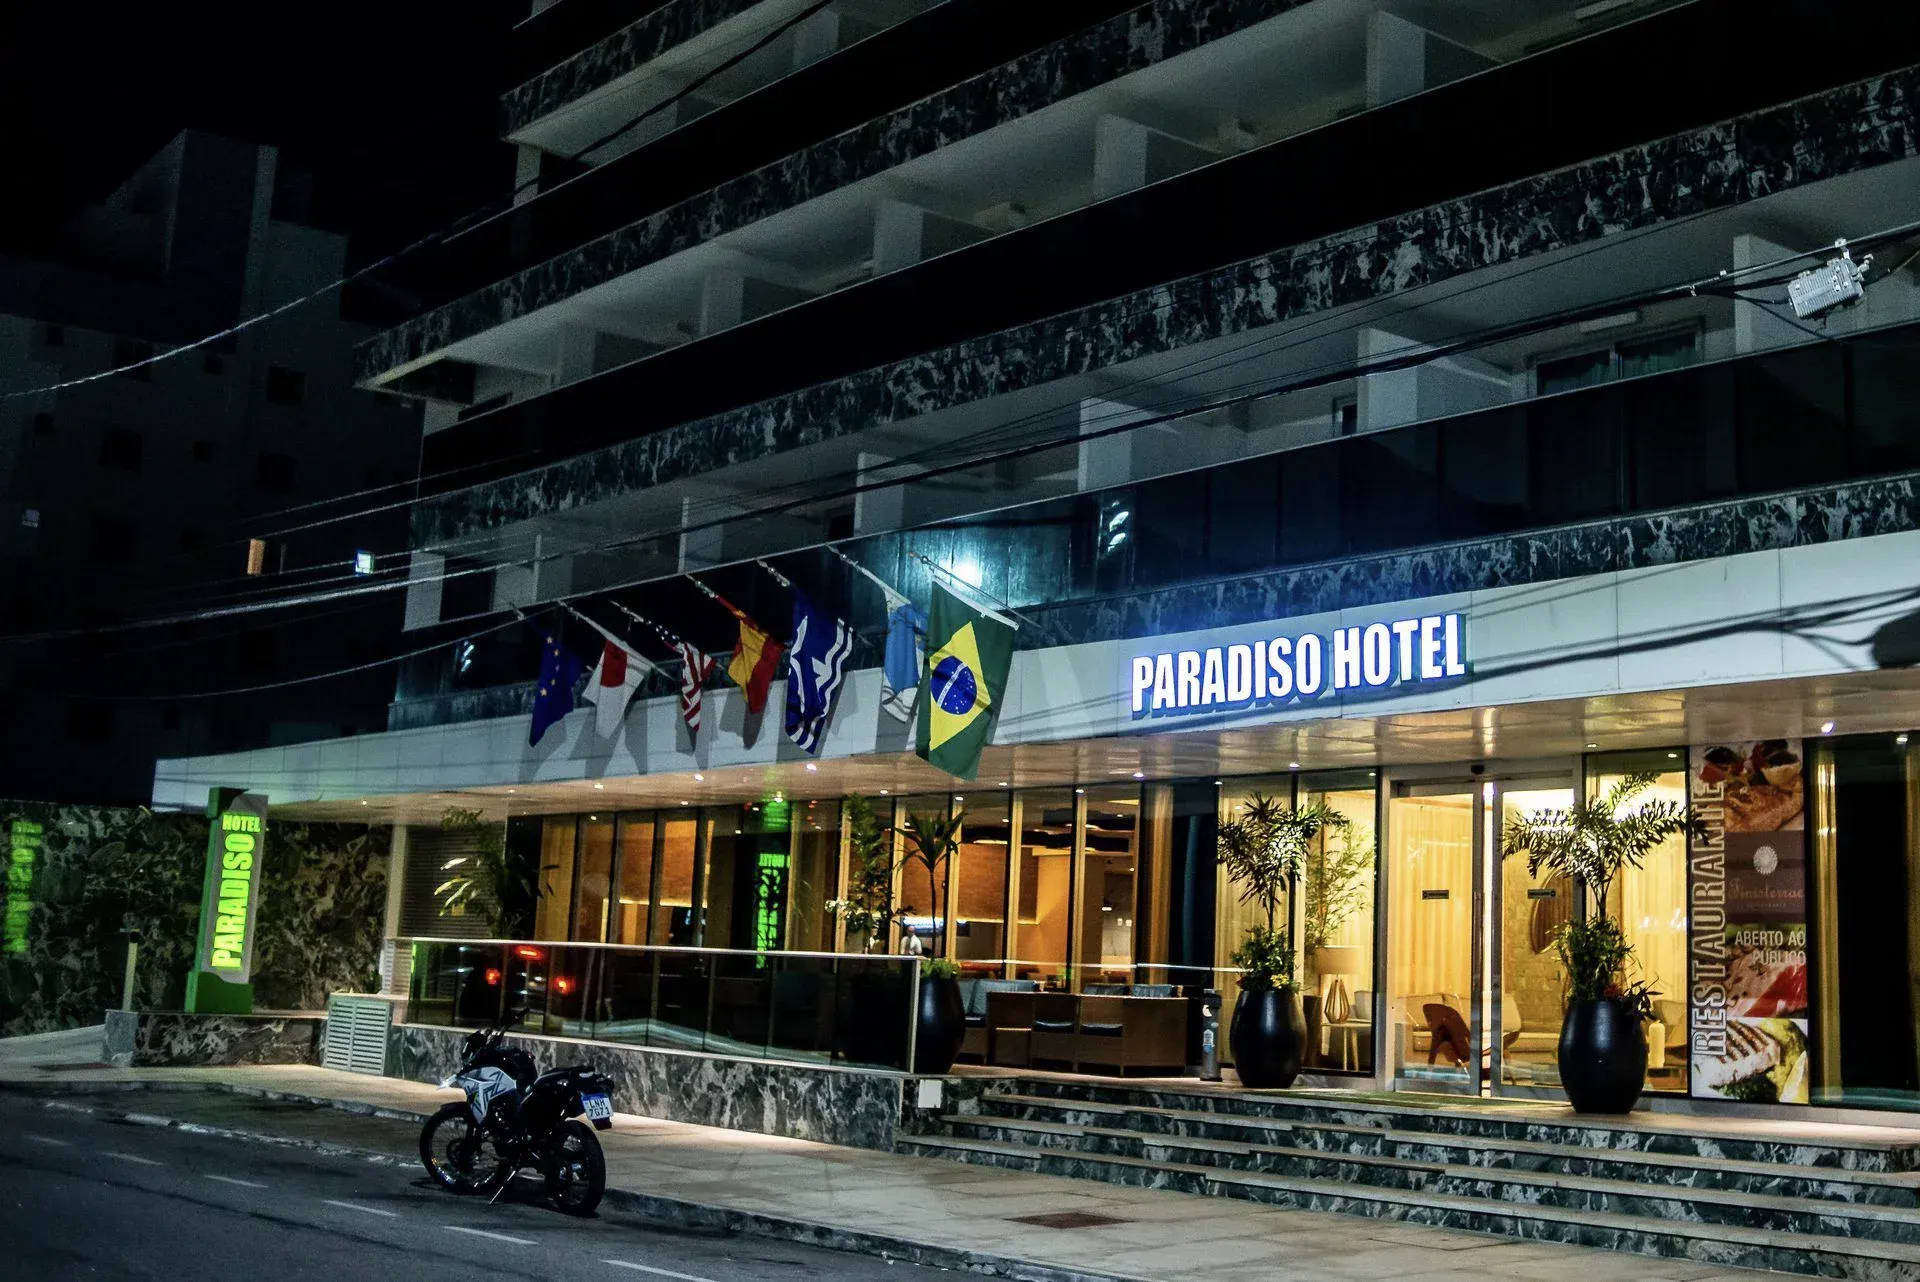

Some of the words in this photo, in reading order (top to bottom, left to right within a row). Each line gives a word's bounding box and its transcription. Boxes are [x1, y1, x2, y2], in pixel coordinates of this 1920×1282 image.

[1132, 633, 1321, 712] PARADISO
[1333, 613, 1466, 689] HOTEL
[222, 814, 261, 832] HOTEL
[211, 833, 255, 968] PARADISO
[1692, 781, 1727, 1056] RESTAURANTE
[1735, 930, 1784, 946] ABERTO
[1788, 930, 1806, 946] AO
[1752, 947, 1807, 966] PÚBLICO
